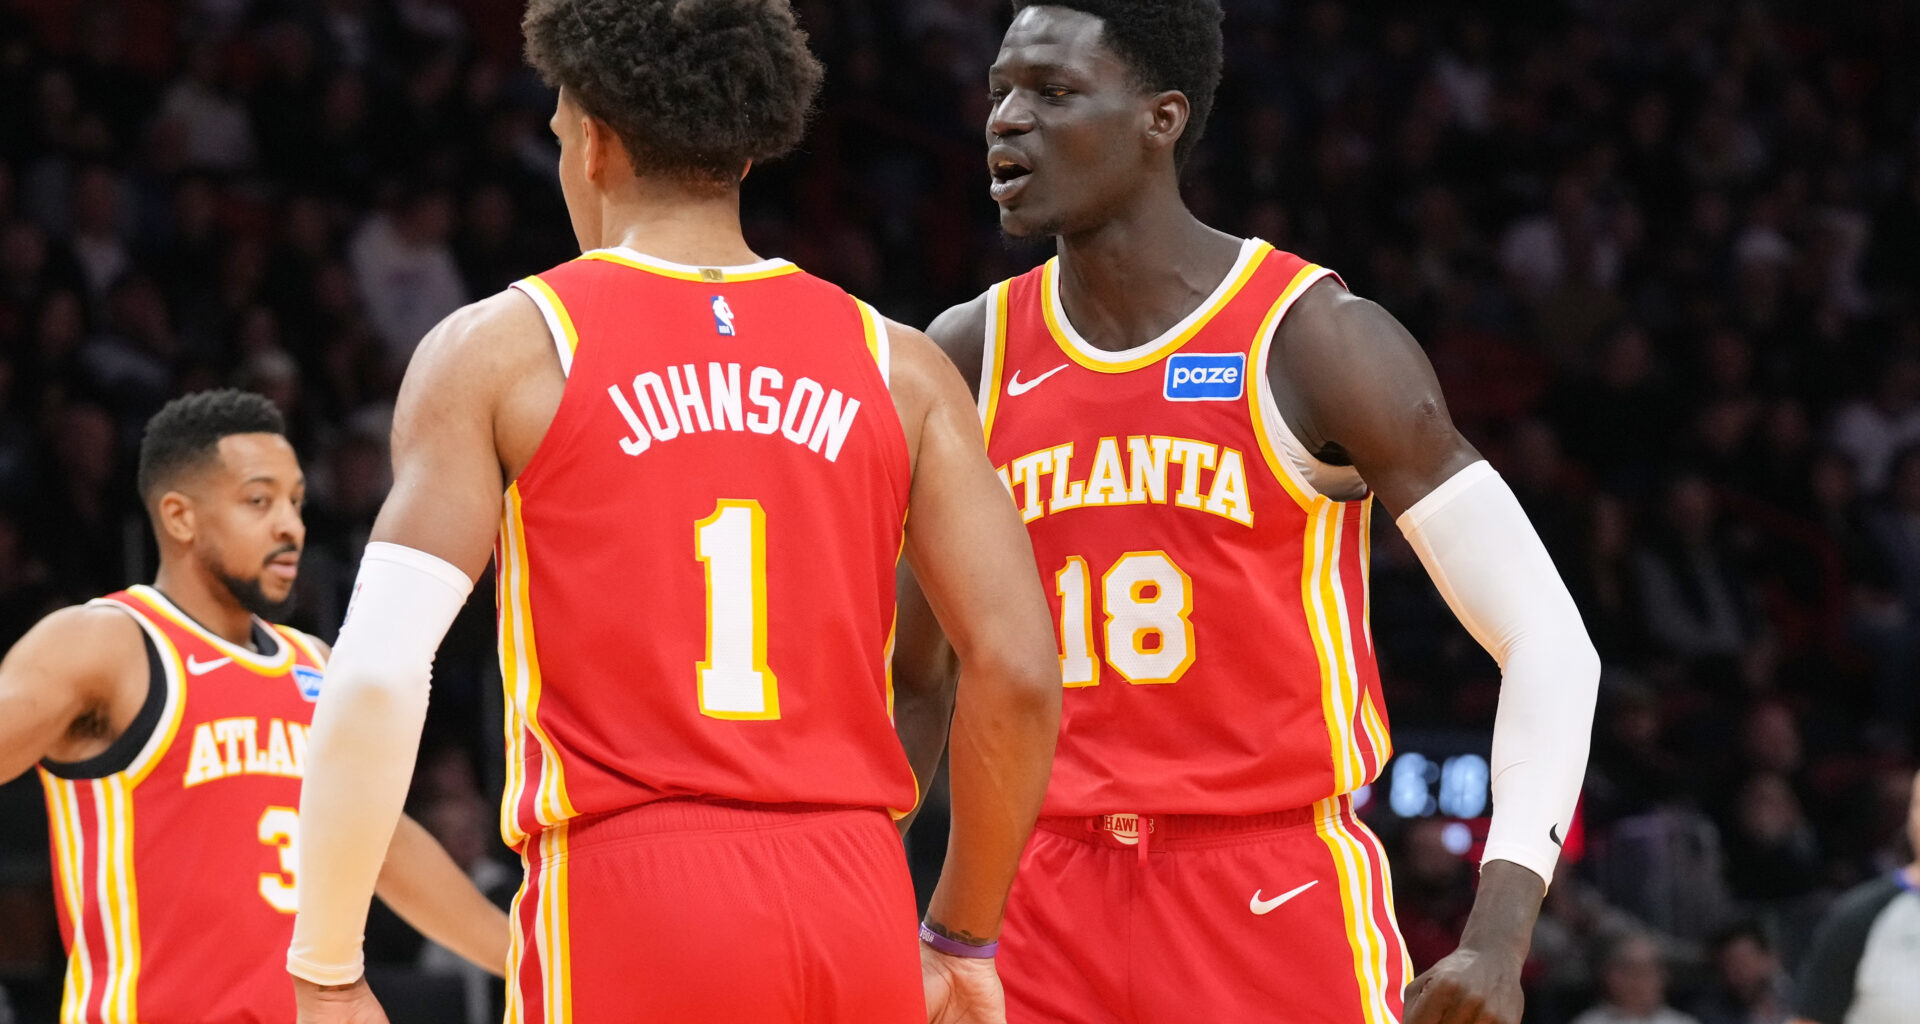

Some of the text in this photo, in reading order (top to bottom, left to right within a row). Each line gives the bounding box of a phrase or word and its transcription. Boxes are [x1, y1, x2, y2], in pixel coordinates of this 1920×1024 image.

[608, 362, 860, 463] JOHNSON
[1172, 367, 1238, 389] paze
[694, 498, 781, 721] 1
[1055, 550, 1196, 688] 18
[183, 716, 312, 789] ATLAN
[257, 805, 300, 914] 3
